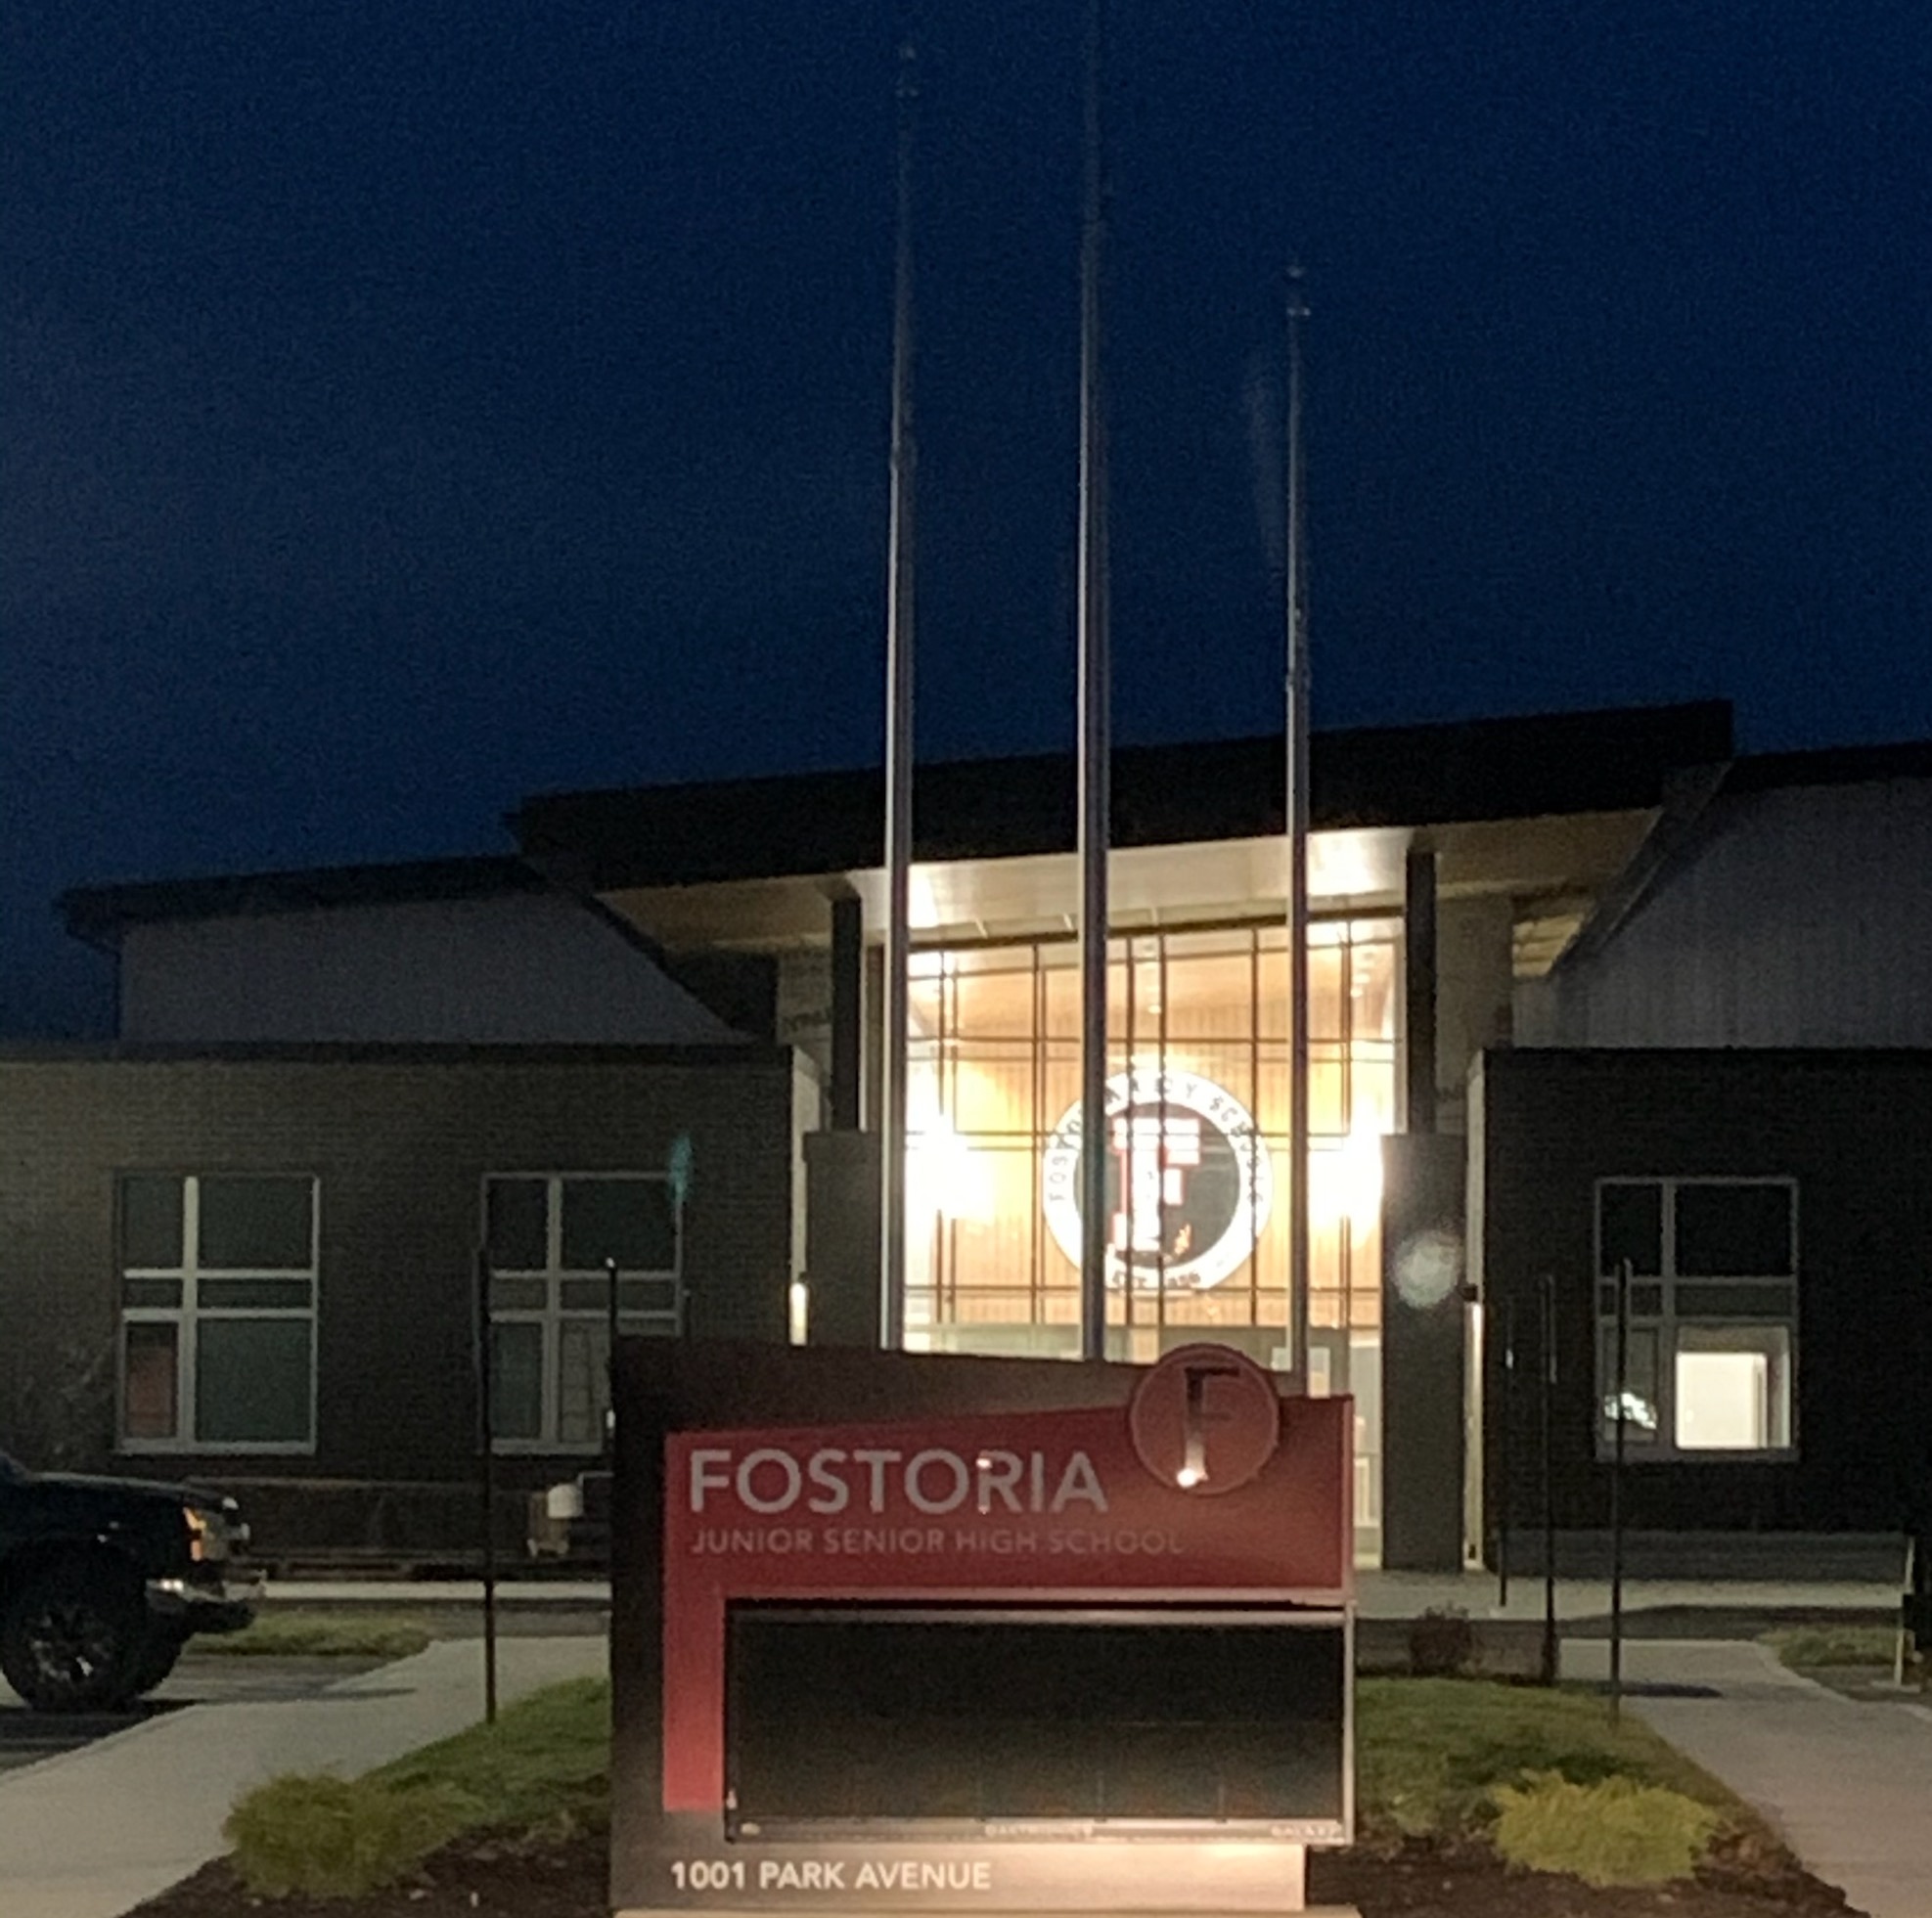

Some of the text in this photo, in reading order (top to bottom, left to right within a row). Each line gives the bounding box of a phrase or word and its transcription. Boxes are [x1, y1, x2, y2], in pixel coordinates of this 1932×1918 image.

[690, 1449, 1108, 1513] FOSTORIA
[692, 1528, 1188, 1555] JUNIOR SENIOR HIGH SCHOOL
[670, 1861, 992, 1890] 1001 PARK AVENUE
